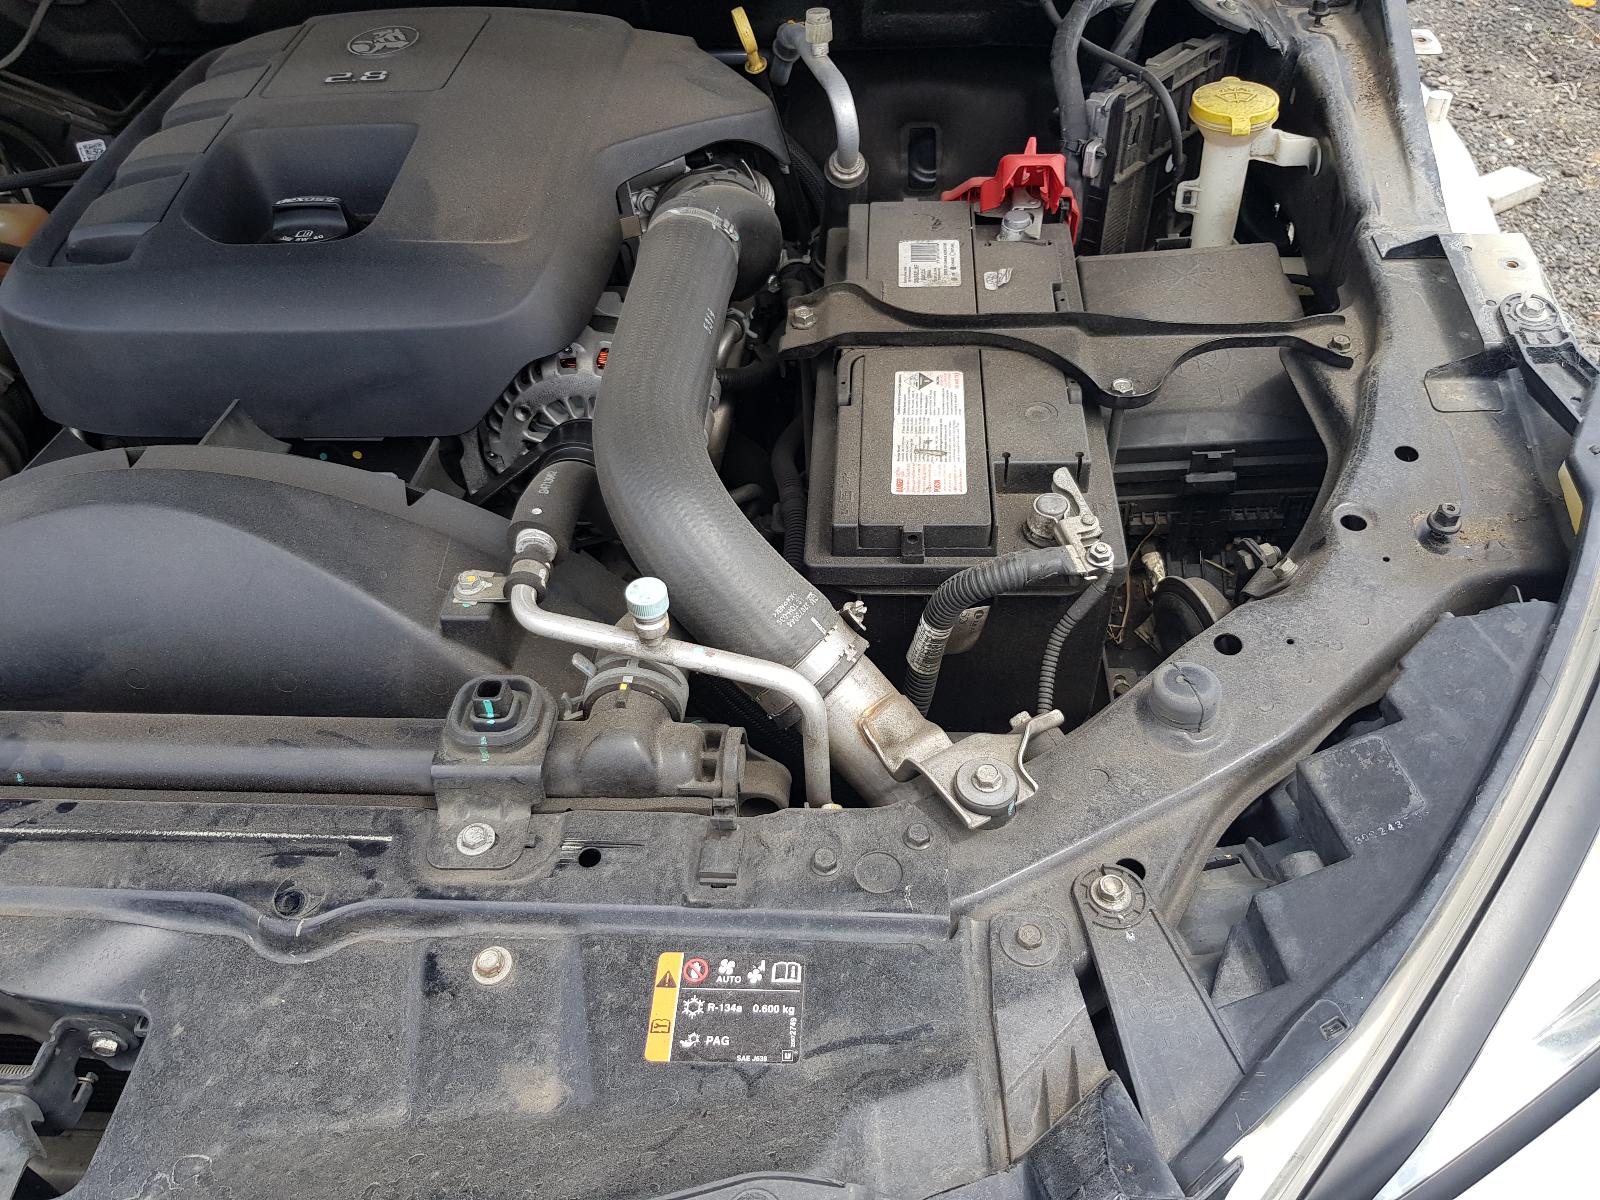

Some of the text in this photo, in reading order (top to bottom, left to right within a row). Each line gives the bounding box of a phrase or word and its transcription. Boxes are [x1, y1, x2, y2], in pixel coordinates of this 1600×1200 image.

[324, 70, 388, 83] 2.8
[715, 975, 742, 984] AUTO
[707, 1003, 795, 1016] R-134a 0.600 kg
[705, 1036, 730, 1046] PAG
